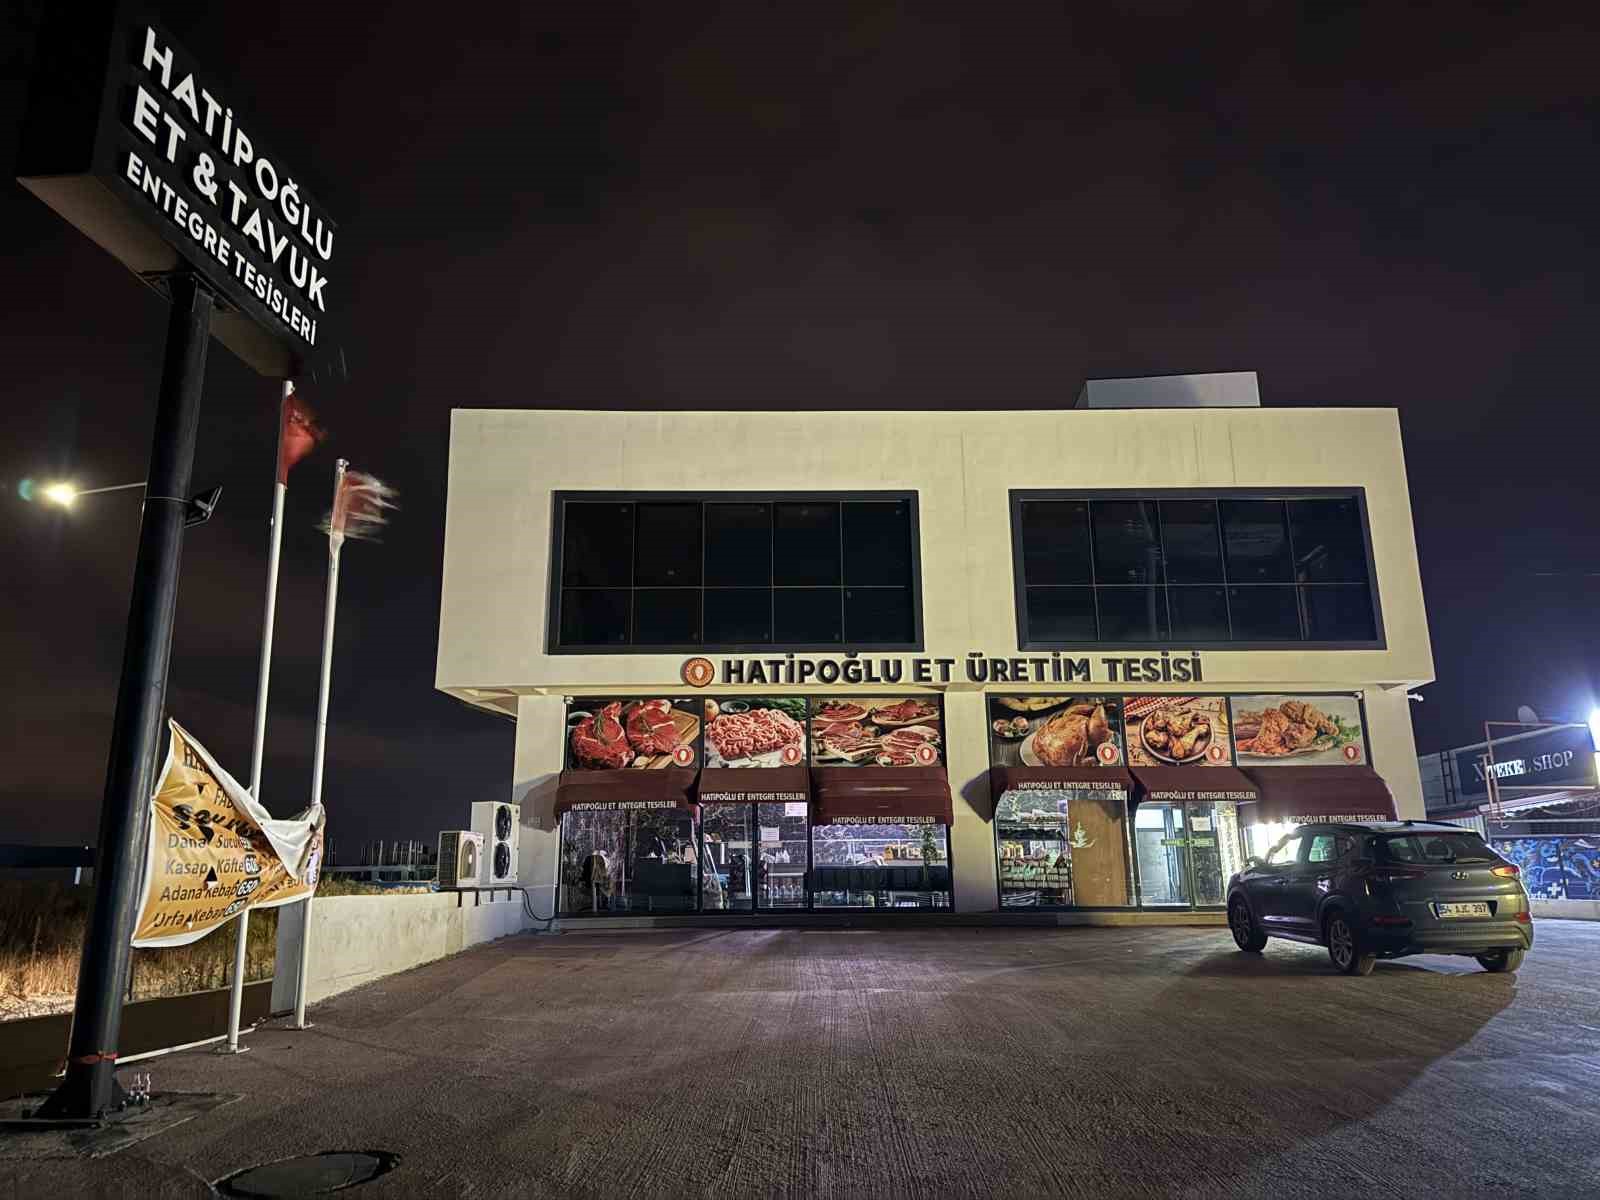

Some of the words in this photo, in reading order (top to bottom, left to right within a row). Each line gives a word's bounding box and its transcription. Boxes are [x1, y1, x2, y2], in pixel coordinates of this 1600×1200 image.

[143, 26, 333, 261] HATİPOĞLU
[133, 85, 186, 163] ET
[193, 152, 217, 205] &
[228, 180, 328, 312] TAVUK
[126, 152, 229, 267] ENTEGRE
[234, 251, 317, 345] TESİSLERİ
[721, 651, 902, 684] HATİPOĞLU
[912, 658, 955, 683] ET
[966, 651, 1092, 683] ÜRETİM
[1101, 651, 1202, 682] TESİSİ
[1532, 750, 1573, 771] SHOP
[1053, 782, 1060, 790] ET
[737, 793, 745, 801] ET
[1187, 791, 1195, 800] ET
[608, 802, 617, 810] ET
[868, 816, 876, 824] ET
[168, 833, 206, 849] Dana
[166, 859, 208, 876] Kasap
[216, 858, 244, 874] Köfte
[161, 884, 202, 901] Adana
[154, 911, 185, 928] Urfa
